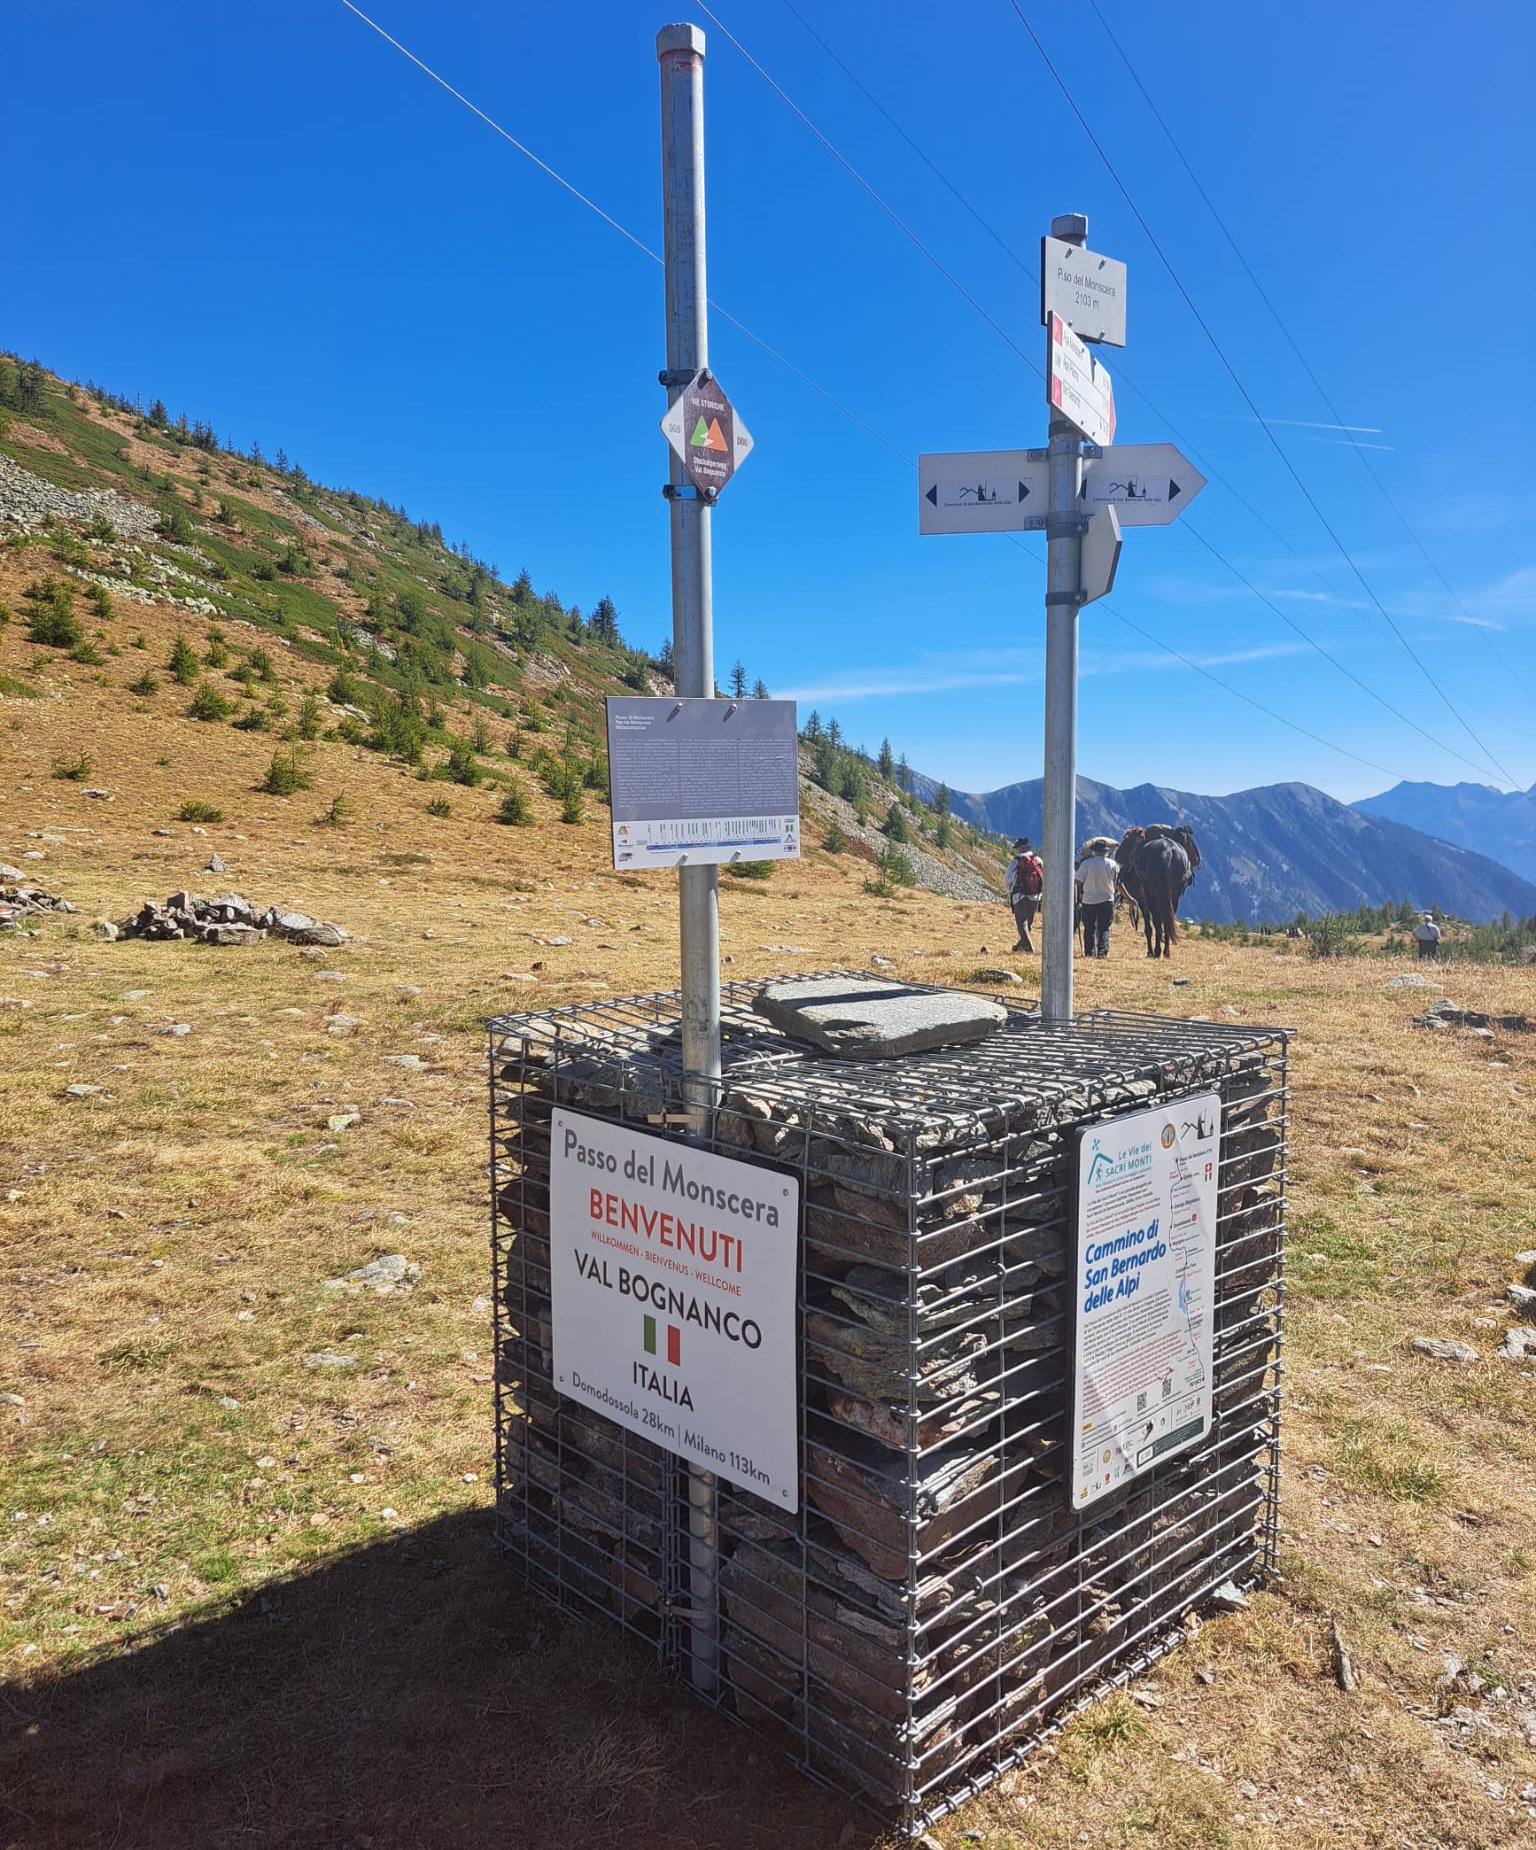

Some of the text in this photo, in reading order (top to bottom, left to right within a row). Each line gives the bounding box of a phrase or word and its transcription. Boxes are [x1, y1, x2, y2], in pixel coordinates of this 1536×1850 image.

[1057, 267, 1116, 298] P.so del Monscera
[1075, 291, 1100, 309] 2103 m
[1105, 1162, 1126, 1178] SACRI
[1128, 1154, 1152, 1170] MONTI
[1118, 1151, 1127, 1160] Le
[1128, 1145, 1140, 1157] Vie
[564, 1128, 779, 1228] Passo del Monscera
[589, 1187, 742, 1273] BENVENUTI
[1085, 1229, 1145, 1264] Cammino
[1146, 1218, 1160, 1238] di
[590, 1229, 640, 1257] WILLKOMMEN
[645, 1251, 689, 1276] BIENVENUS
[694, 1269, 741, 1296] WELLCOME
[1084, 1265, 1109, 1290] San
[1111, 1240, 1167, 1278] Bernardo
[574, 1248, 762, 1349] VAL BOGNANCO
[1084, 1271, 1141, 1314] delle Alpi
[632, 1360, 695, 1412] ITALIA
[571, 1371, 639, 1419] Domodossola
[641, 1408, 675, 1438] 28km
[684, 1429, 726, 1463] Milano
[729, 1451, 770, 1485] 113km
